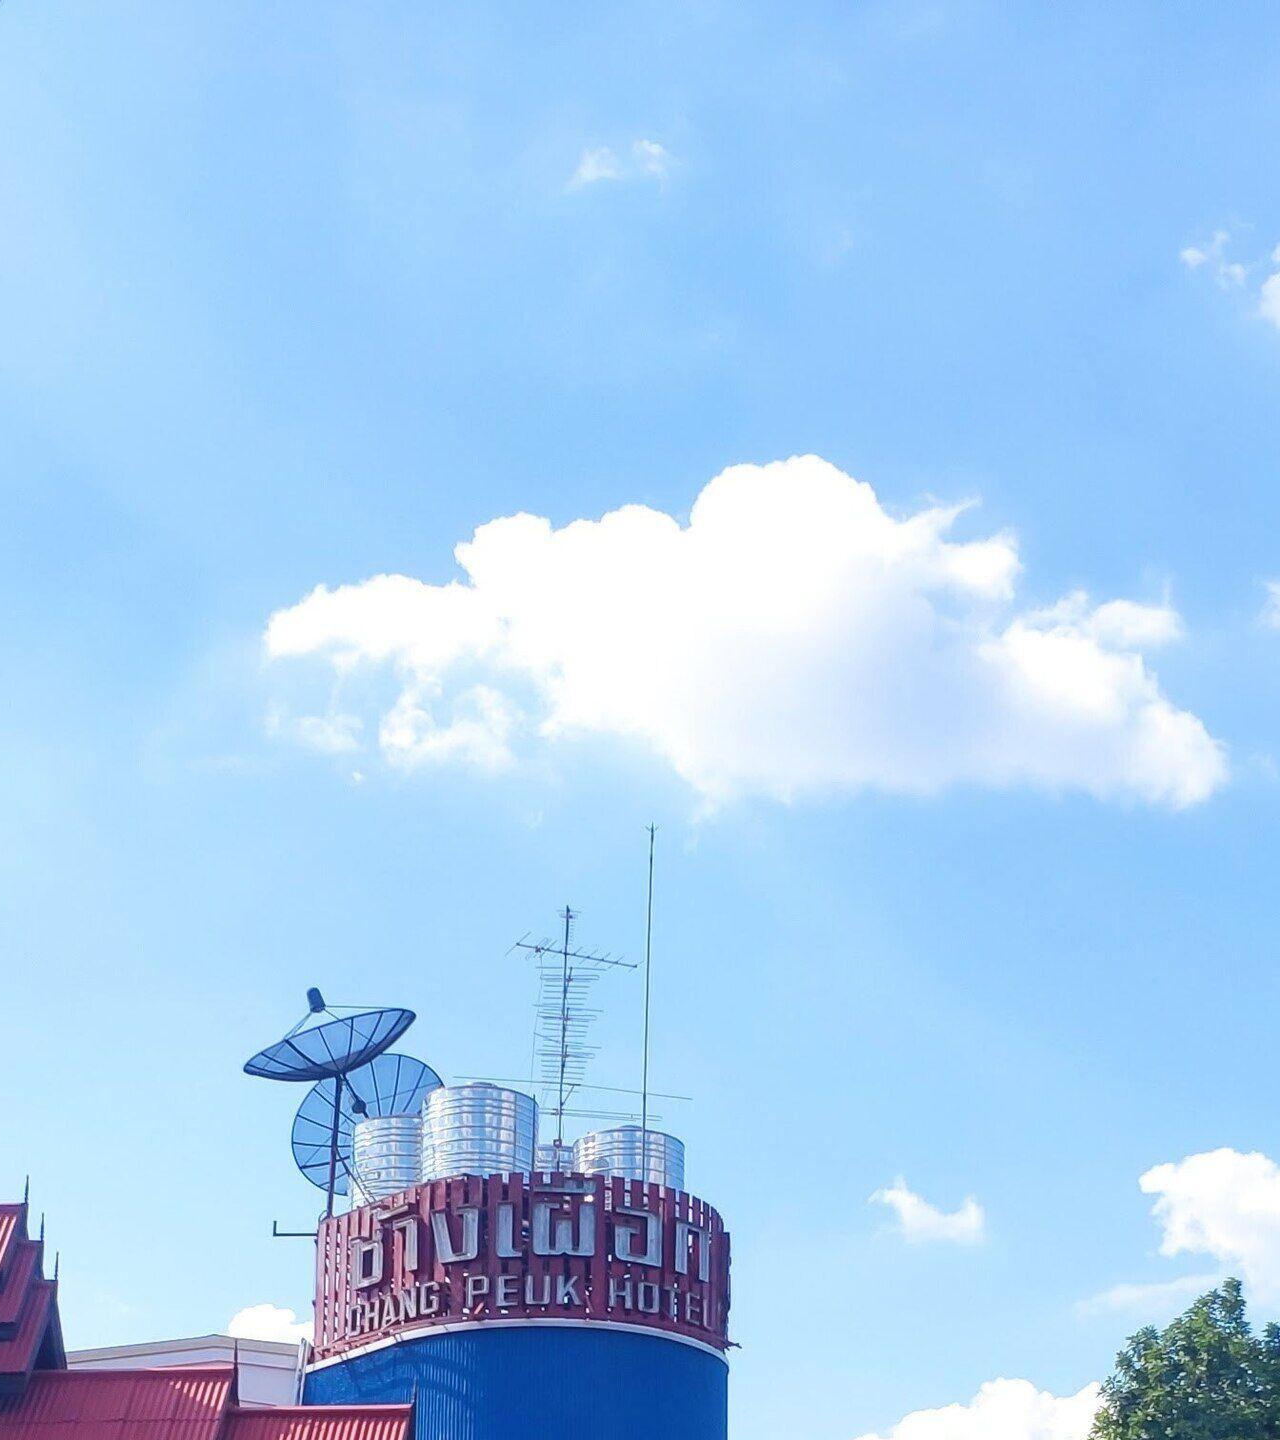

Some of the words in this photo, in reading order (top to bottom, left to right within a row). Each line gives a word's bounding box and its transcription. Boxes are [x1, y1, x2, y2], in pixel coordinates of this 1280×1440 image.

[349, 1179, 711, 1291] ช้างเผือก
[346, 1280, 440, 1338] CHANG
[465, 1274, 583, 1308] PEUK
[608, 1276, 715, 1330] HOTEL
